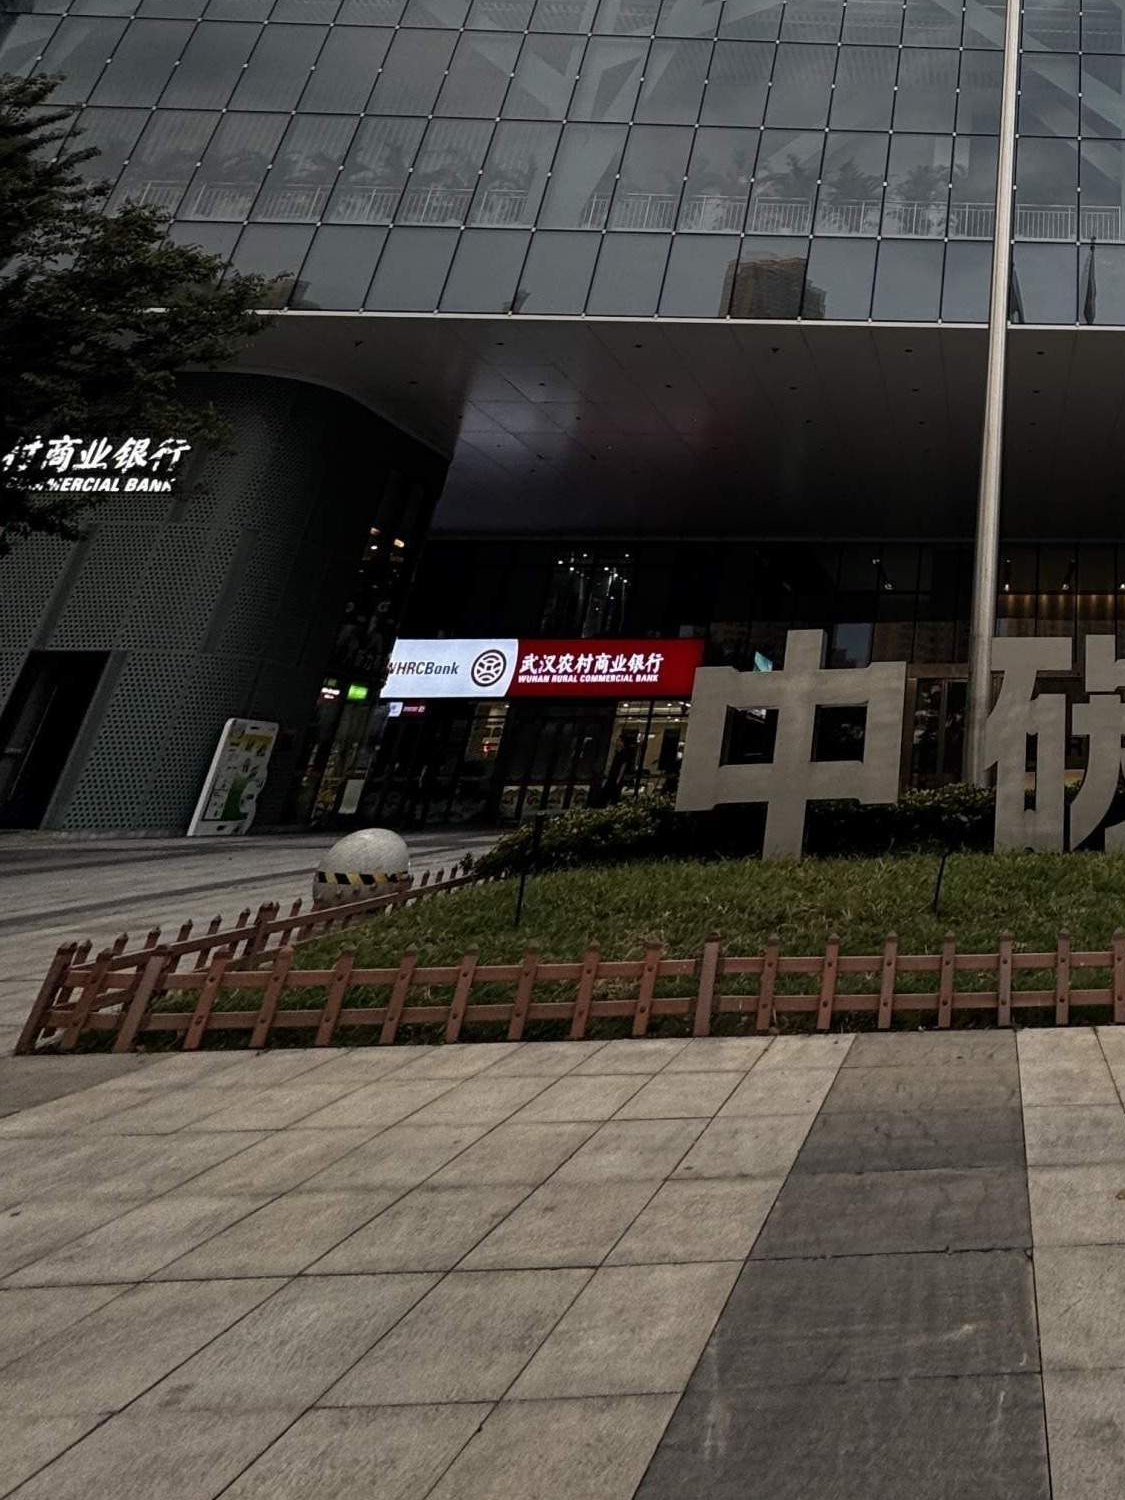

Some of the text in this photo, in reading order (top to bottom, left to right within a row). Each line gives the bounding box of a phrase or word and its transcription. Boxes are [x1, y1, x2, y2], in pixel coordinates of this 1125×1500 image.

[124, 476, 176, 492] BANK
[518, 652, 665, 674] 武汉农村商业银行
[518, 674, 659, 683] WUHAN RURAL COMMERCIAL BANK
